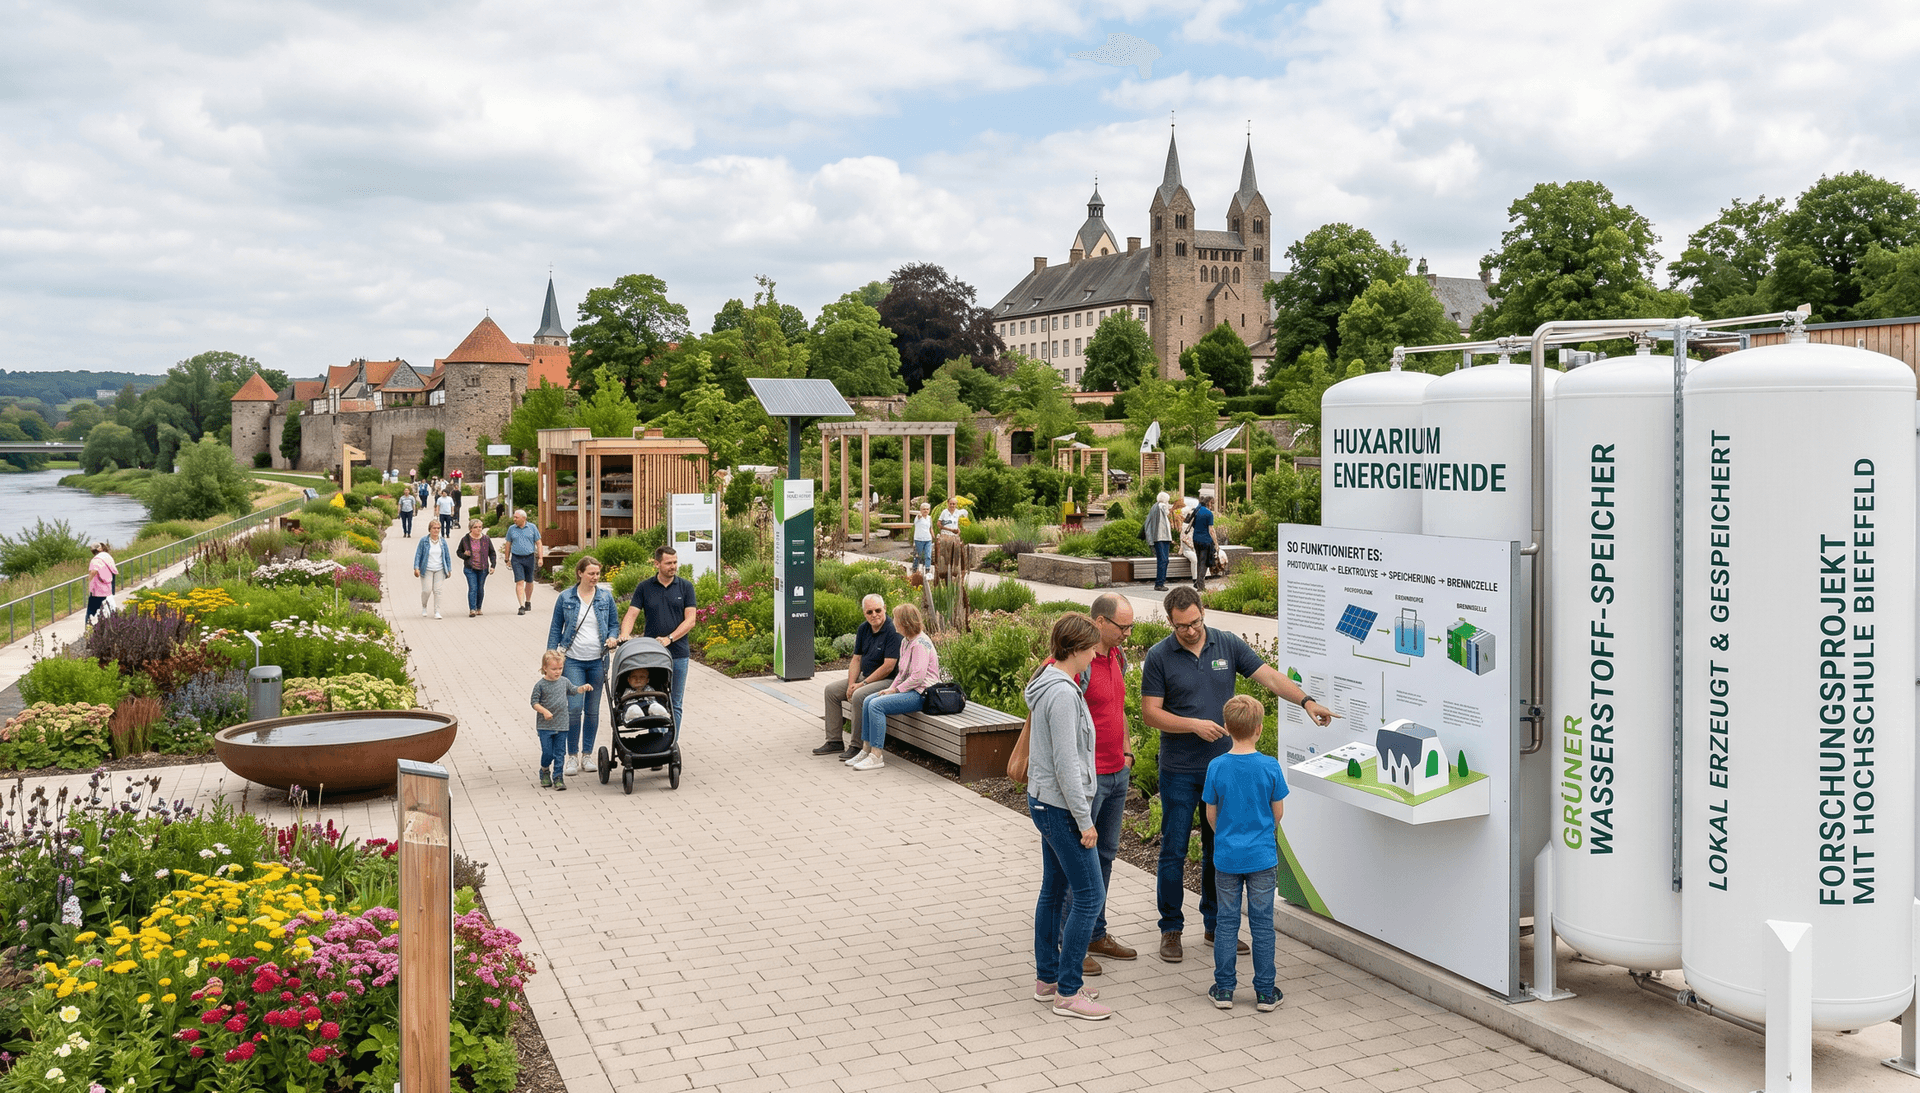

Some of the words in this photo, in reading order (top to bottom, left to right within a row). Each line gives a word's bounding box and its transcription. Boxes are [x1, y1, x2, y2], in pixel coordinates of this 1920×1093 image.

[1333, 426, 1441, 455] HUXARIUM
[1334, 462, 1507, 493] ENERGIEWENDE
[1287, 541, 1298, 553] SO
[1300, 542, 1365, 560] FUNKTIONIERT
[1367, 548, 1382, 562] ES:
[1287, 560, 1328, 572] PHOTOVOLTAIK
[1338, 566, 1378, 578] ELEKTROLYSE
[1388, 571, 1436, 584] SPEICHERUNG
[1710, 429, 1731, 623] GESPEICHERT
[1853, 458, 1875, 613] BIEFEFELD
[1590, 443, 1615, 855] WASSERSTOFF-SPEICHER
[1709, 633, 1730, 652] &
[1709, 659, 1729, 789] ERZEUGT
[1819, 533, 1846, 905] FORSCHUNGSPROJEKT
[1853, 624, 1875, 835] HOCHSCHULE
[1560, 715, 1583, 850] GRÜNER
[1708, 800, 1728, 892] LOKAL
[1853, 845, 1875, 905] MIT
